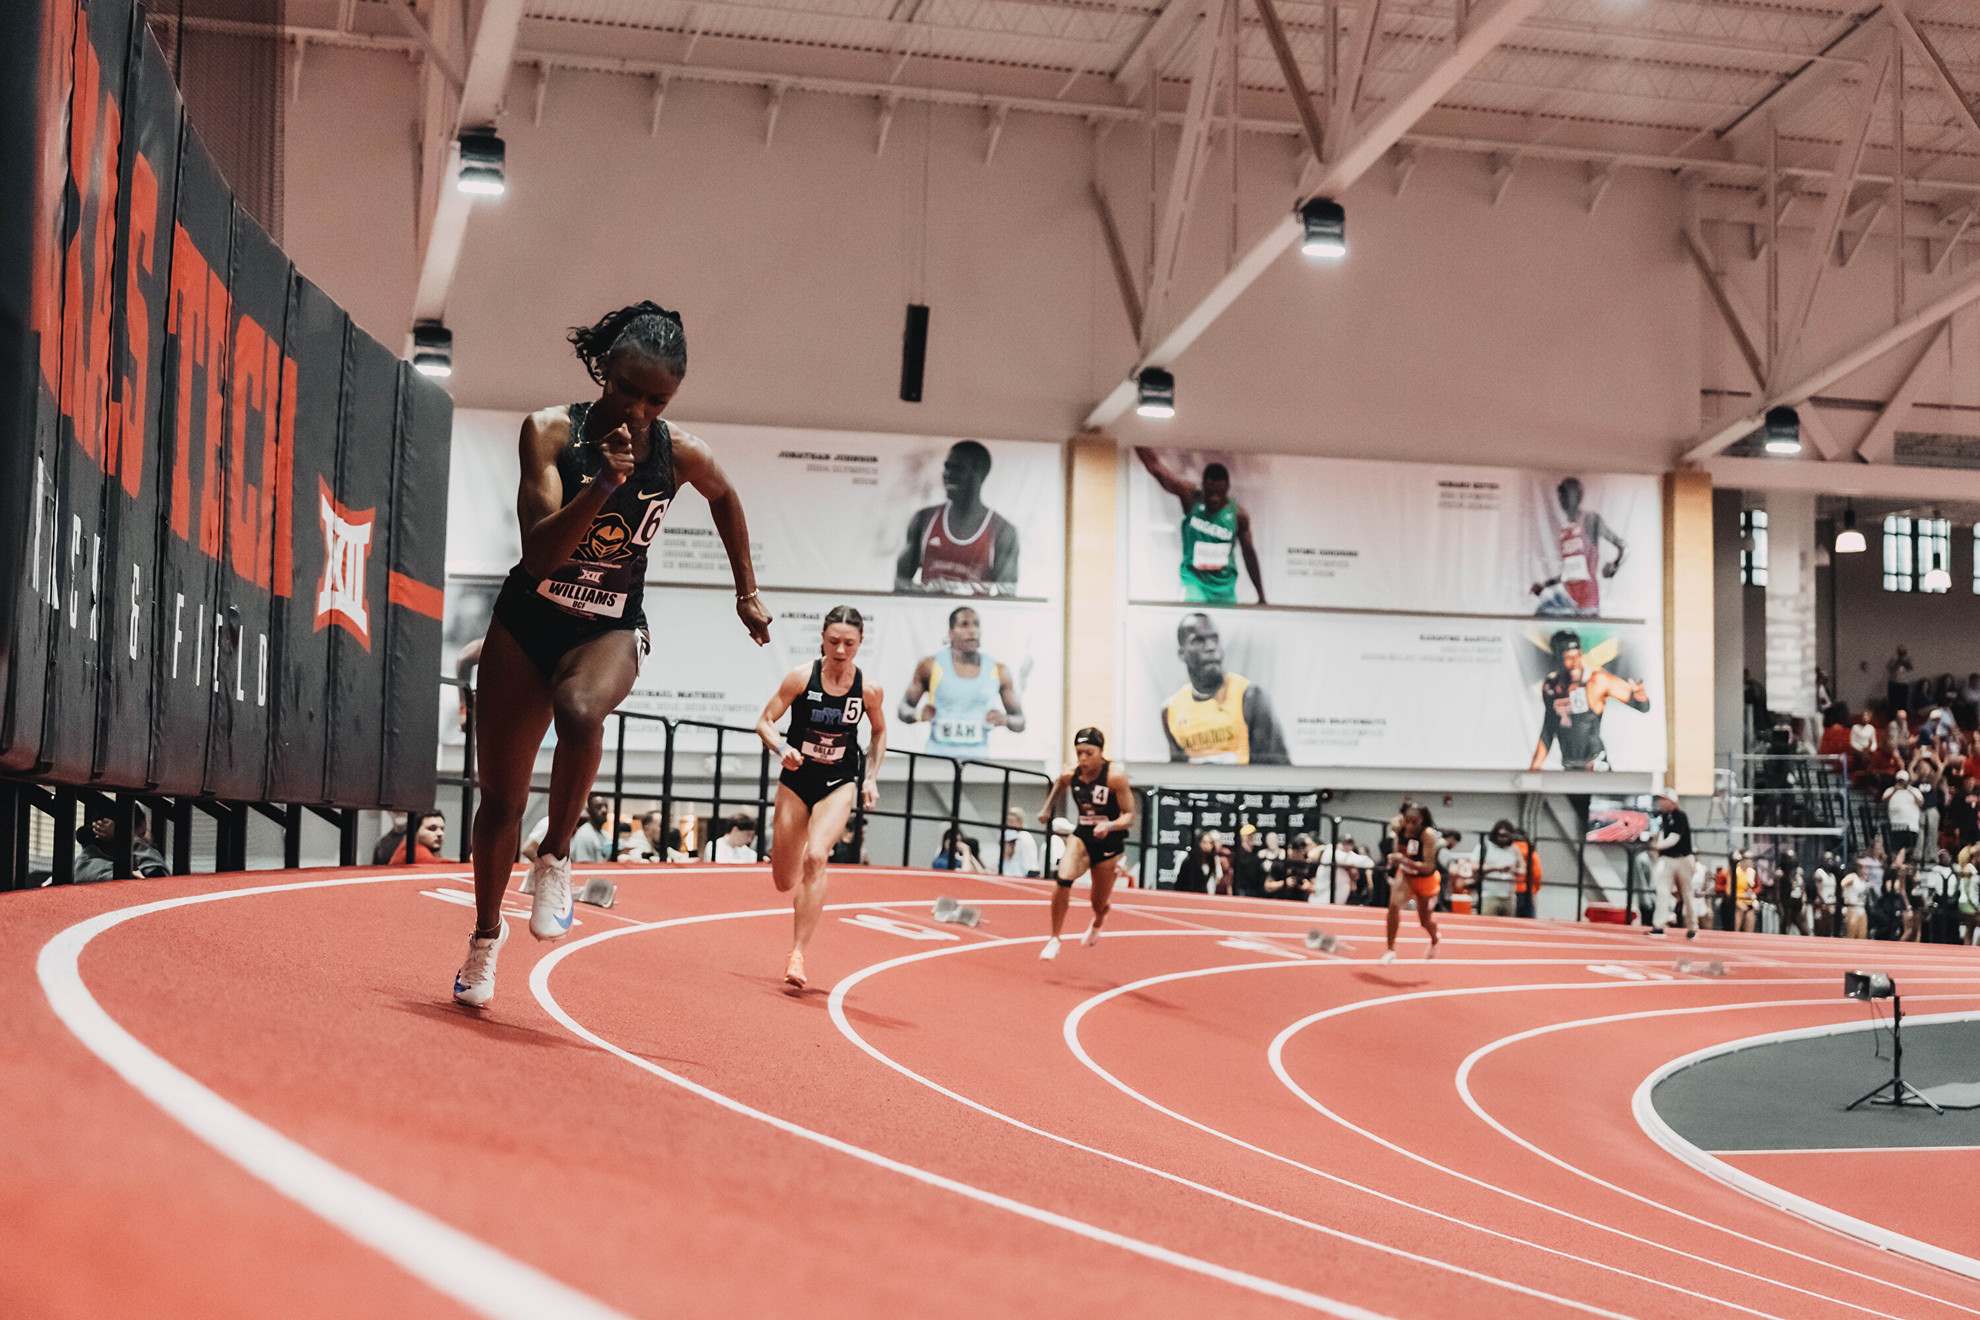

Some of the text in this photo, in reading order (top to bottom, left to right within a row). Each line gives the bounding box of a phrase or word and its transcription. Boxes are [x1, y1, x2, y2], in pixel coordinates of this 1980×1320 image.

[168, 221, 298, 599] TECH
[640, 503, 665, 543] 6
[548, 581, 618, 607] WILLIAMS
[572, 600, 587, 610] UCF
[129, 563, 140, 661] &
[172, 592, 268, 707] FIELD
[846, 699, 859, 721] 5
